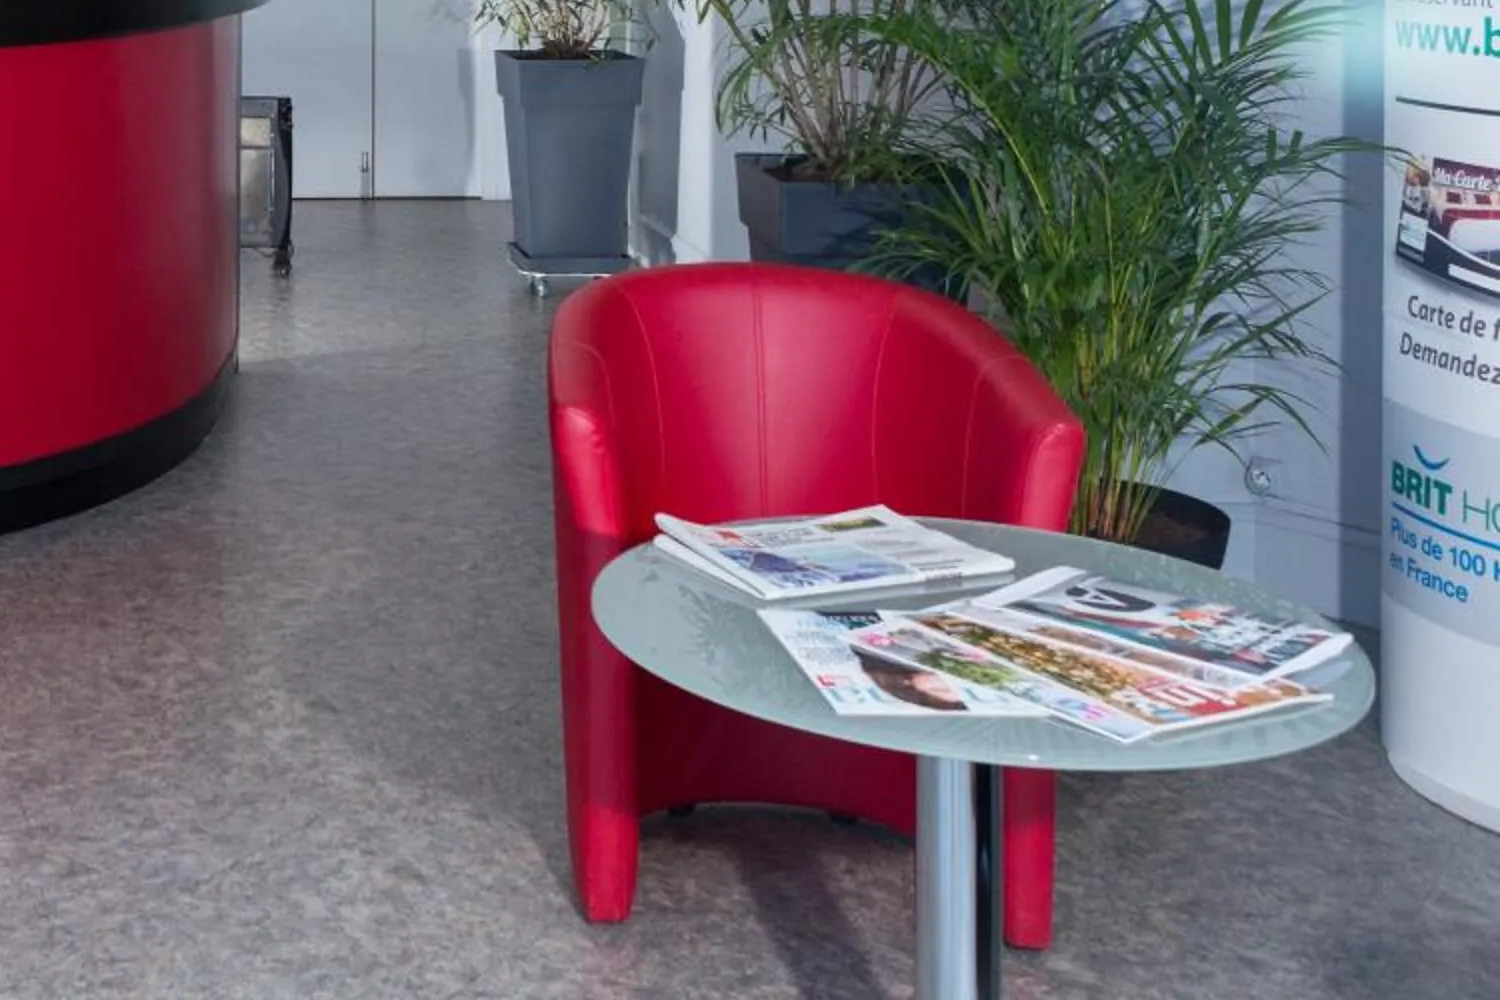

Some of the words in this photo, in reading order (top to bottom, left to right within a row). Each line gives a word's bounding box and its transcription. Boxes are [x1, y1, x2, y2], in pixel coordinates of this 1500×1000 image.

[1407, 295, 1456, 329] Carte
[1459, 310, 1487, 337] de
[1400, 331, 1500, 385] Demandez
[1392, 460, 1453, 516] BRIT
[1390, 517, 1418, 549] Plus
[1421, 536, 1443, 561] de
[1449, 546, 1486, 576] 100
[1407, 557, 1469, 602] France
